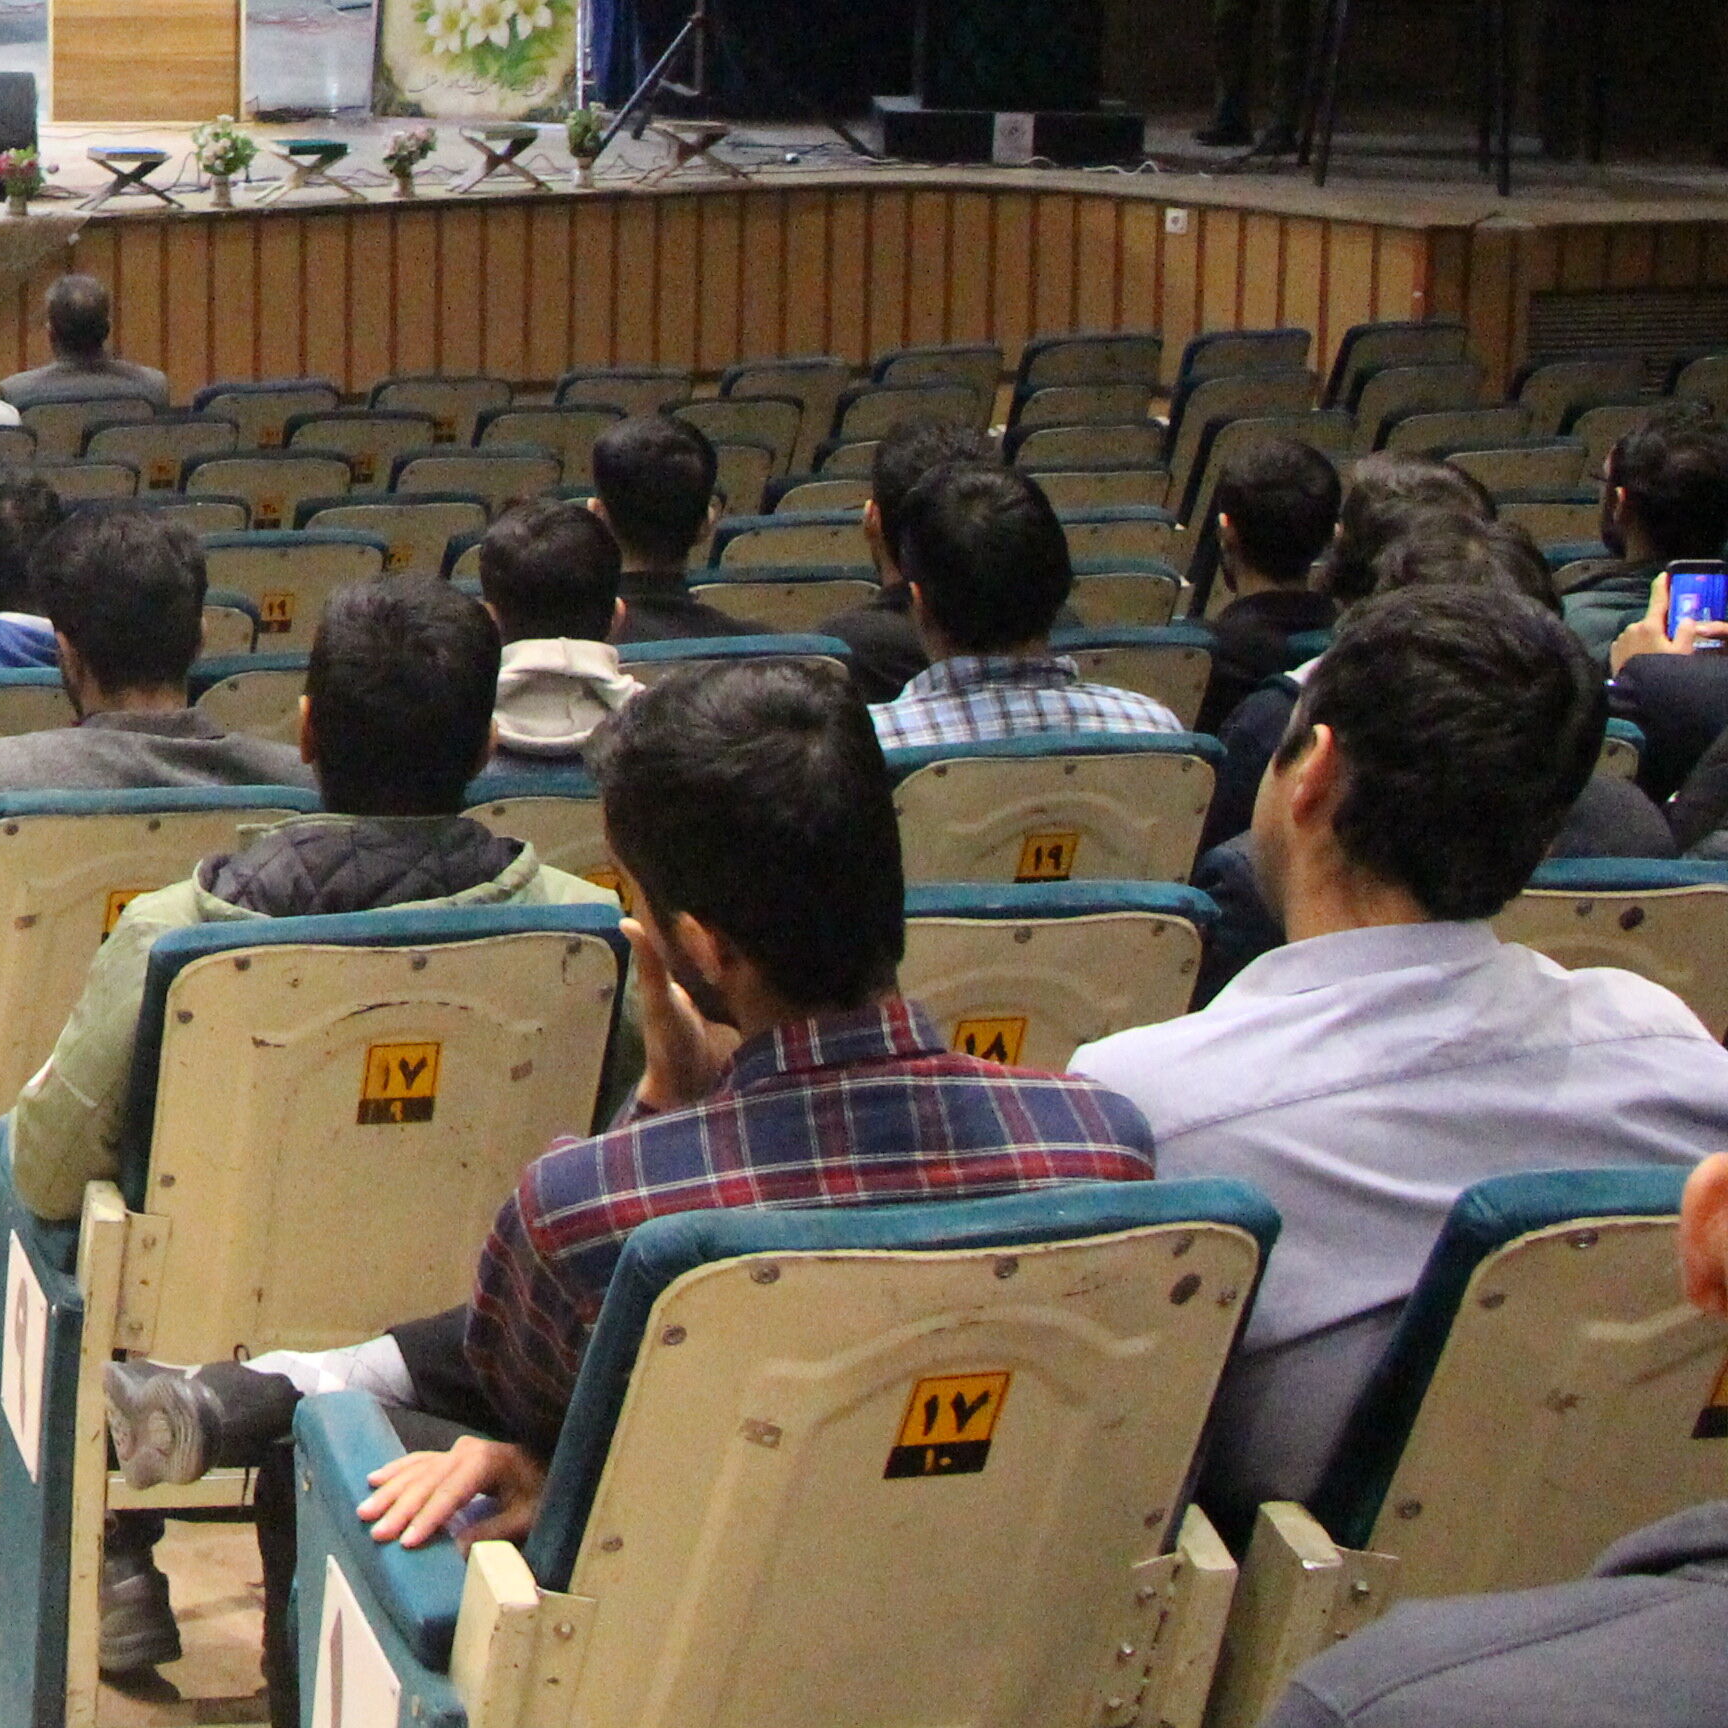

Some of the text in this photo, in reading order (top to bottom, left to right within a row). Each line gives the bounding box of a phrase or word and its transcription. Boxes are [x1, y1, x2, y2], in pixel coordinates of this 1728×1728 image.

[380, 1056, 429, 1092] ۱۷
[12, 1275, 31, 1436] ۹
[924, 1389, 992, 1437] ۱۷
[924, 1449, 954, 1471] ۱۰
